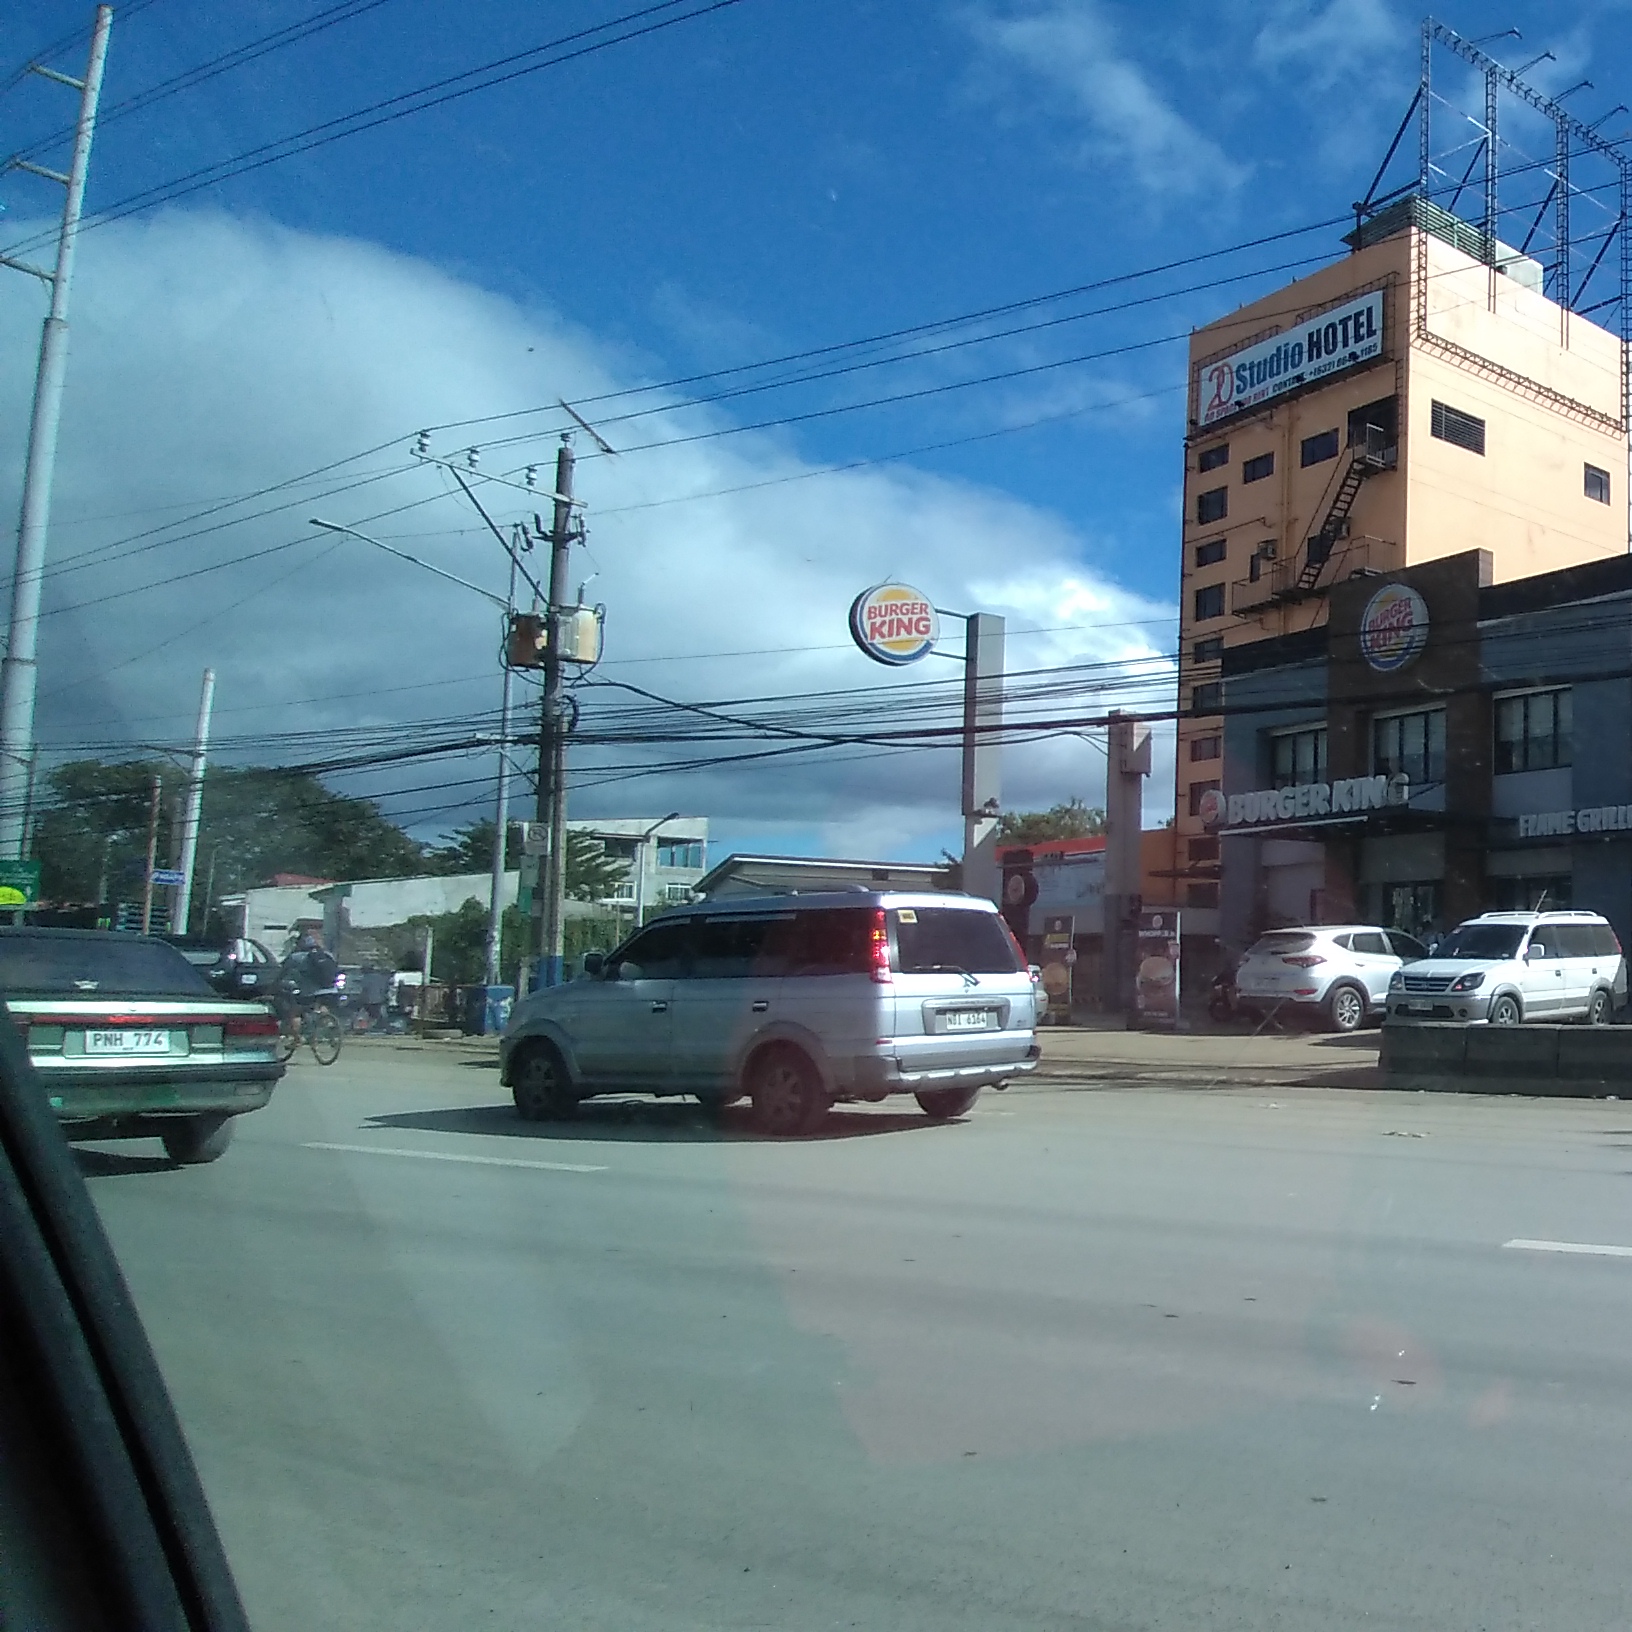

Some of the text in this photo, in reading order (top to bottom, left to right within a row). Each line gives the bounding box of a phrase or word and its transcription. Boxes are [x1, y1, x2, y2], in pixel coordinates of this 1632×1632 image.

[1235, 342, 1304, 395] Studio
[1307, 305, 1378, 363] HOTEL
[867, 602, 929, 621] BURGER
[1369, 597, 1412, 630] BURGER
[869, 616, 932, 642] KING
[1371, 610, 1414, 649] KING
[1228, 772, 1410, 824] BURGER KING
[1519, 810, 1576, 837] FLAME
[93, 1032, 124, 1047] PNH
